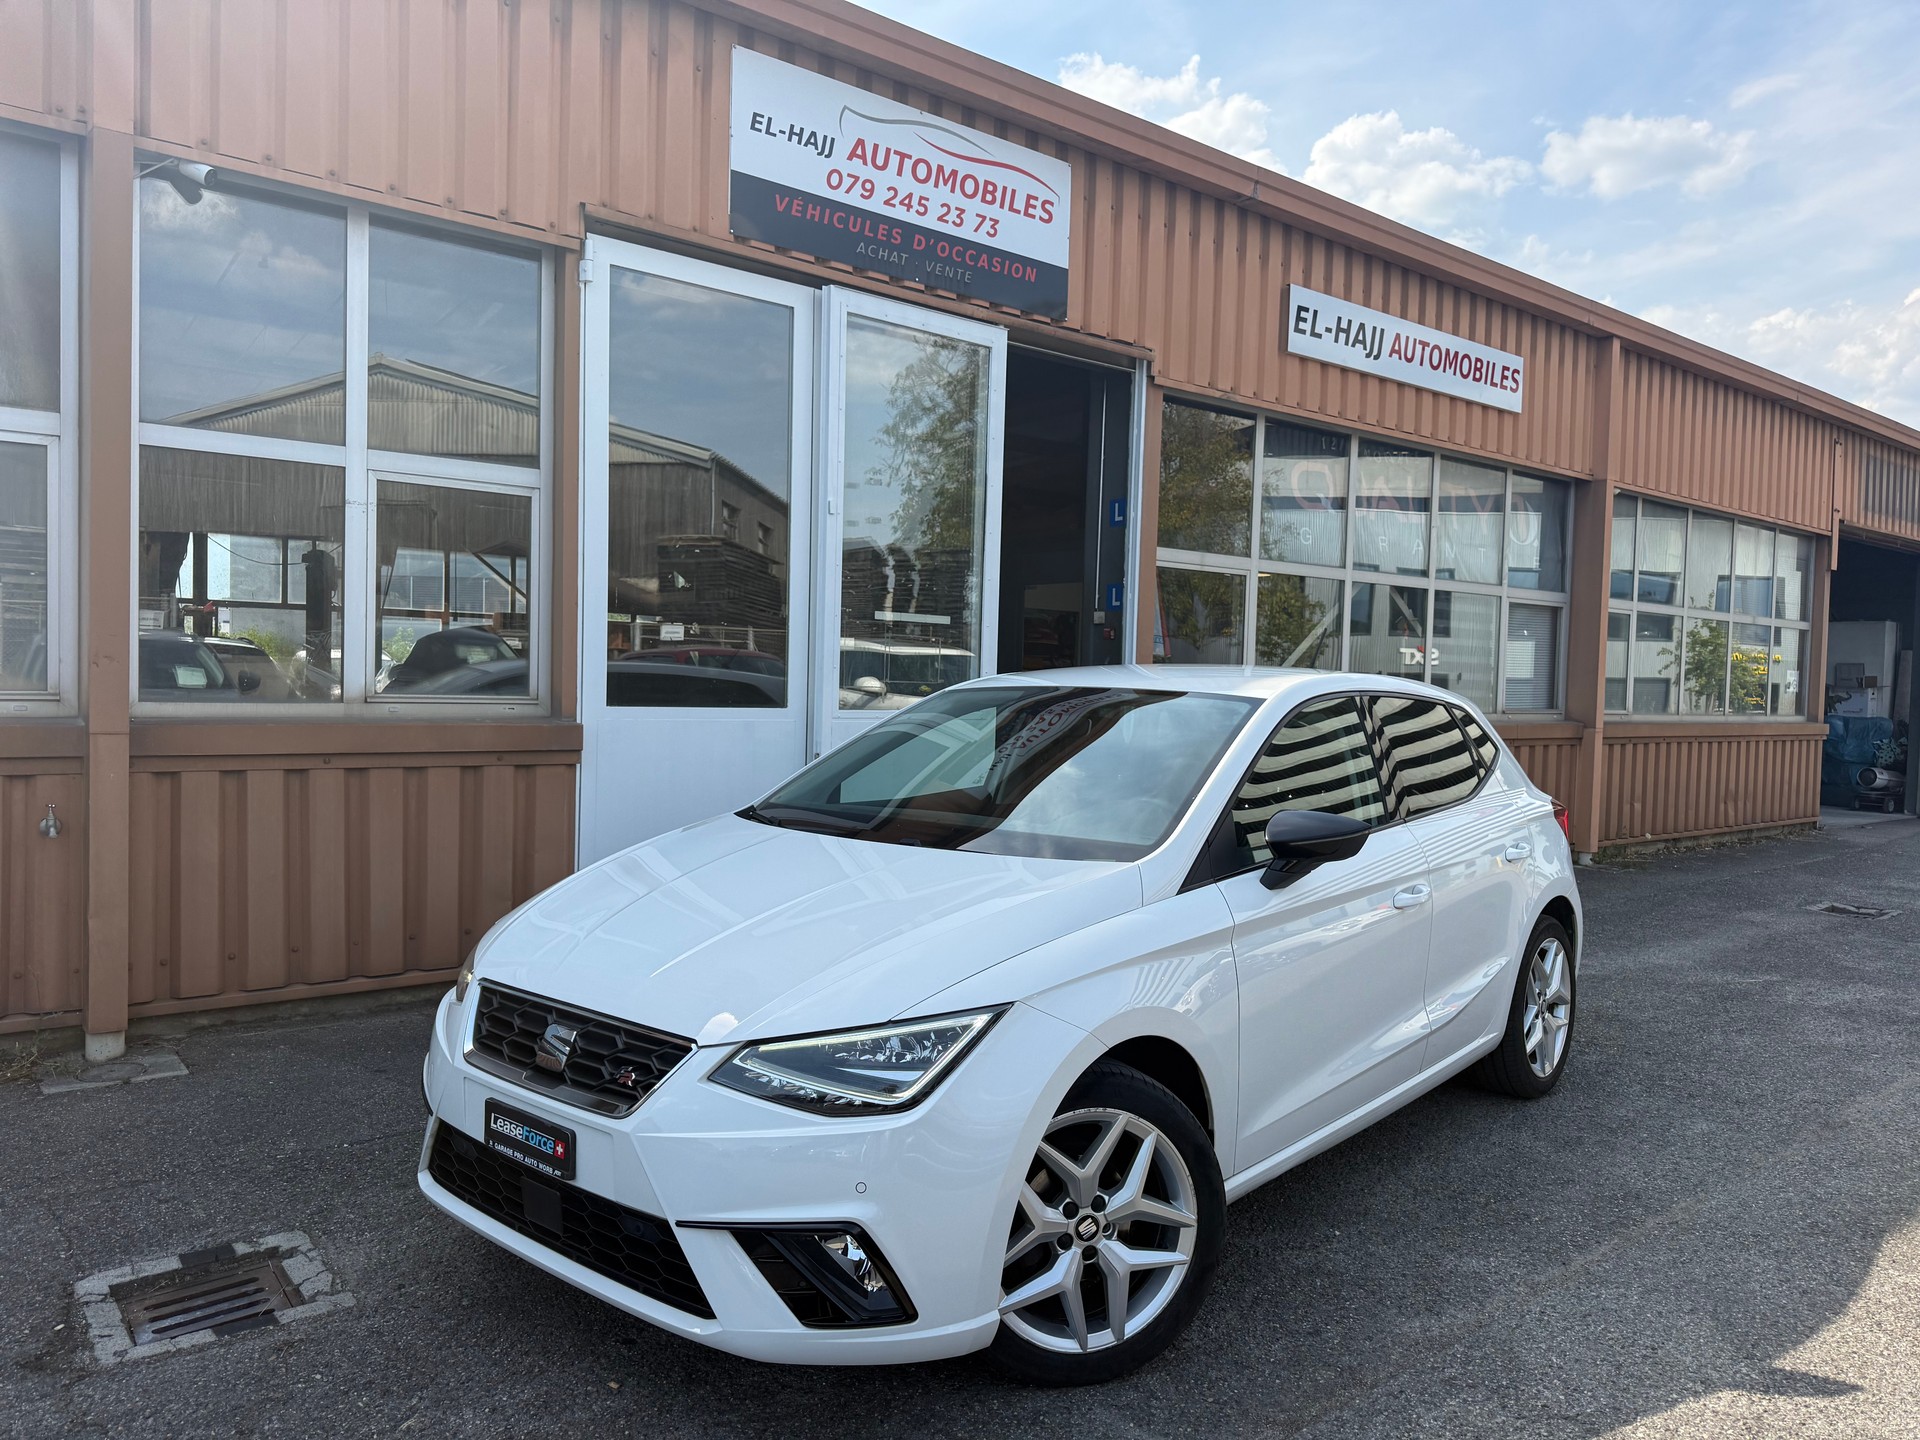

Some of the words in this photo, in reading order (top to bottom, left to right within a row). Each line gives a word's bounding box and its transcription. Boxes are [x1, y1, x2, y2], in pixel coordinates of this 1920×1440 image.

[750, 112, 836, 159] EL-HAJJ
[847, 137, 1055, 224] AUTOMOBILES
[775, 194, 902, 245] VÉHICULES
[826, 169, 875, 200] 079
[883, 186, 930, 217] 245
[936, 203, 967, 229] 23
[973, 213, 1000, 238] 73
[856, 242, 909, 267] ACHAT
[925, 260, 973, 284] VENTE
[1293, 305, 1385, 361] EL-HAJJ
[1388, 332, 1521, 394] AUTOMOBILES
[1115, 503, 1124, 522] L
[1112, 588, 1121, 606] L
[491, 1113, 555, 1153] LeaseForce
[495, 1142, 513, 1156] GARAGE
[514, 1151, 524, 1161] PRO
[524, 1156, 538, 1167] AUTO
